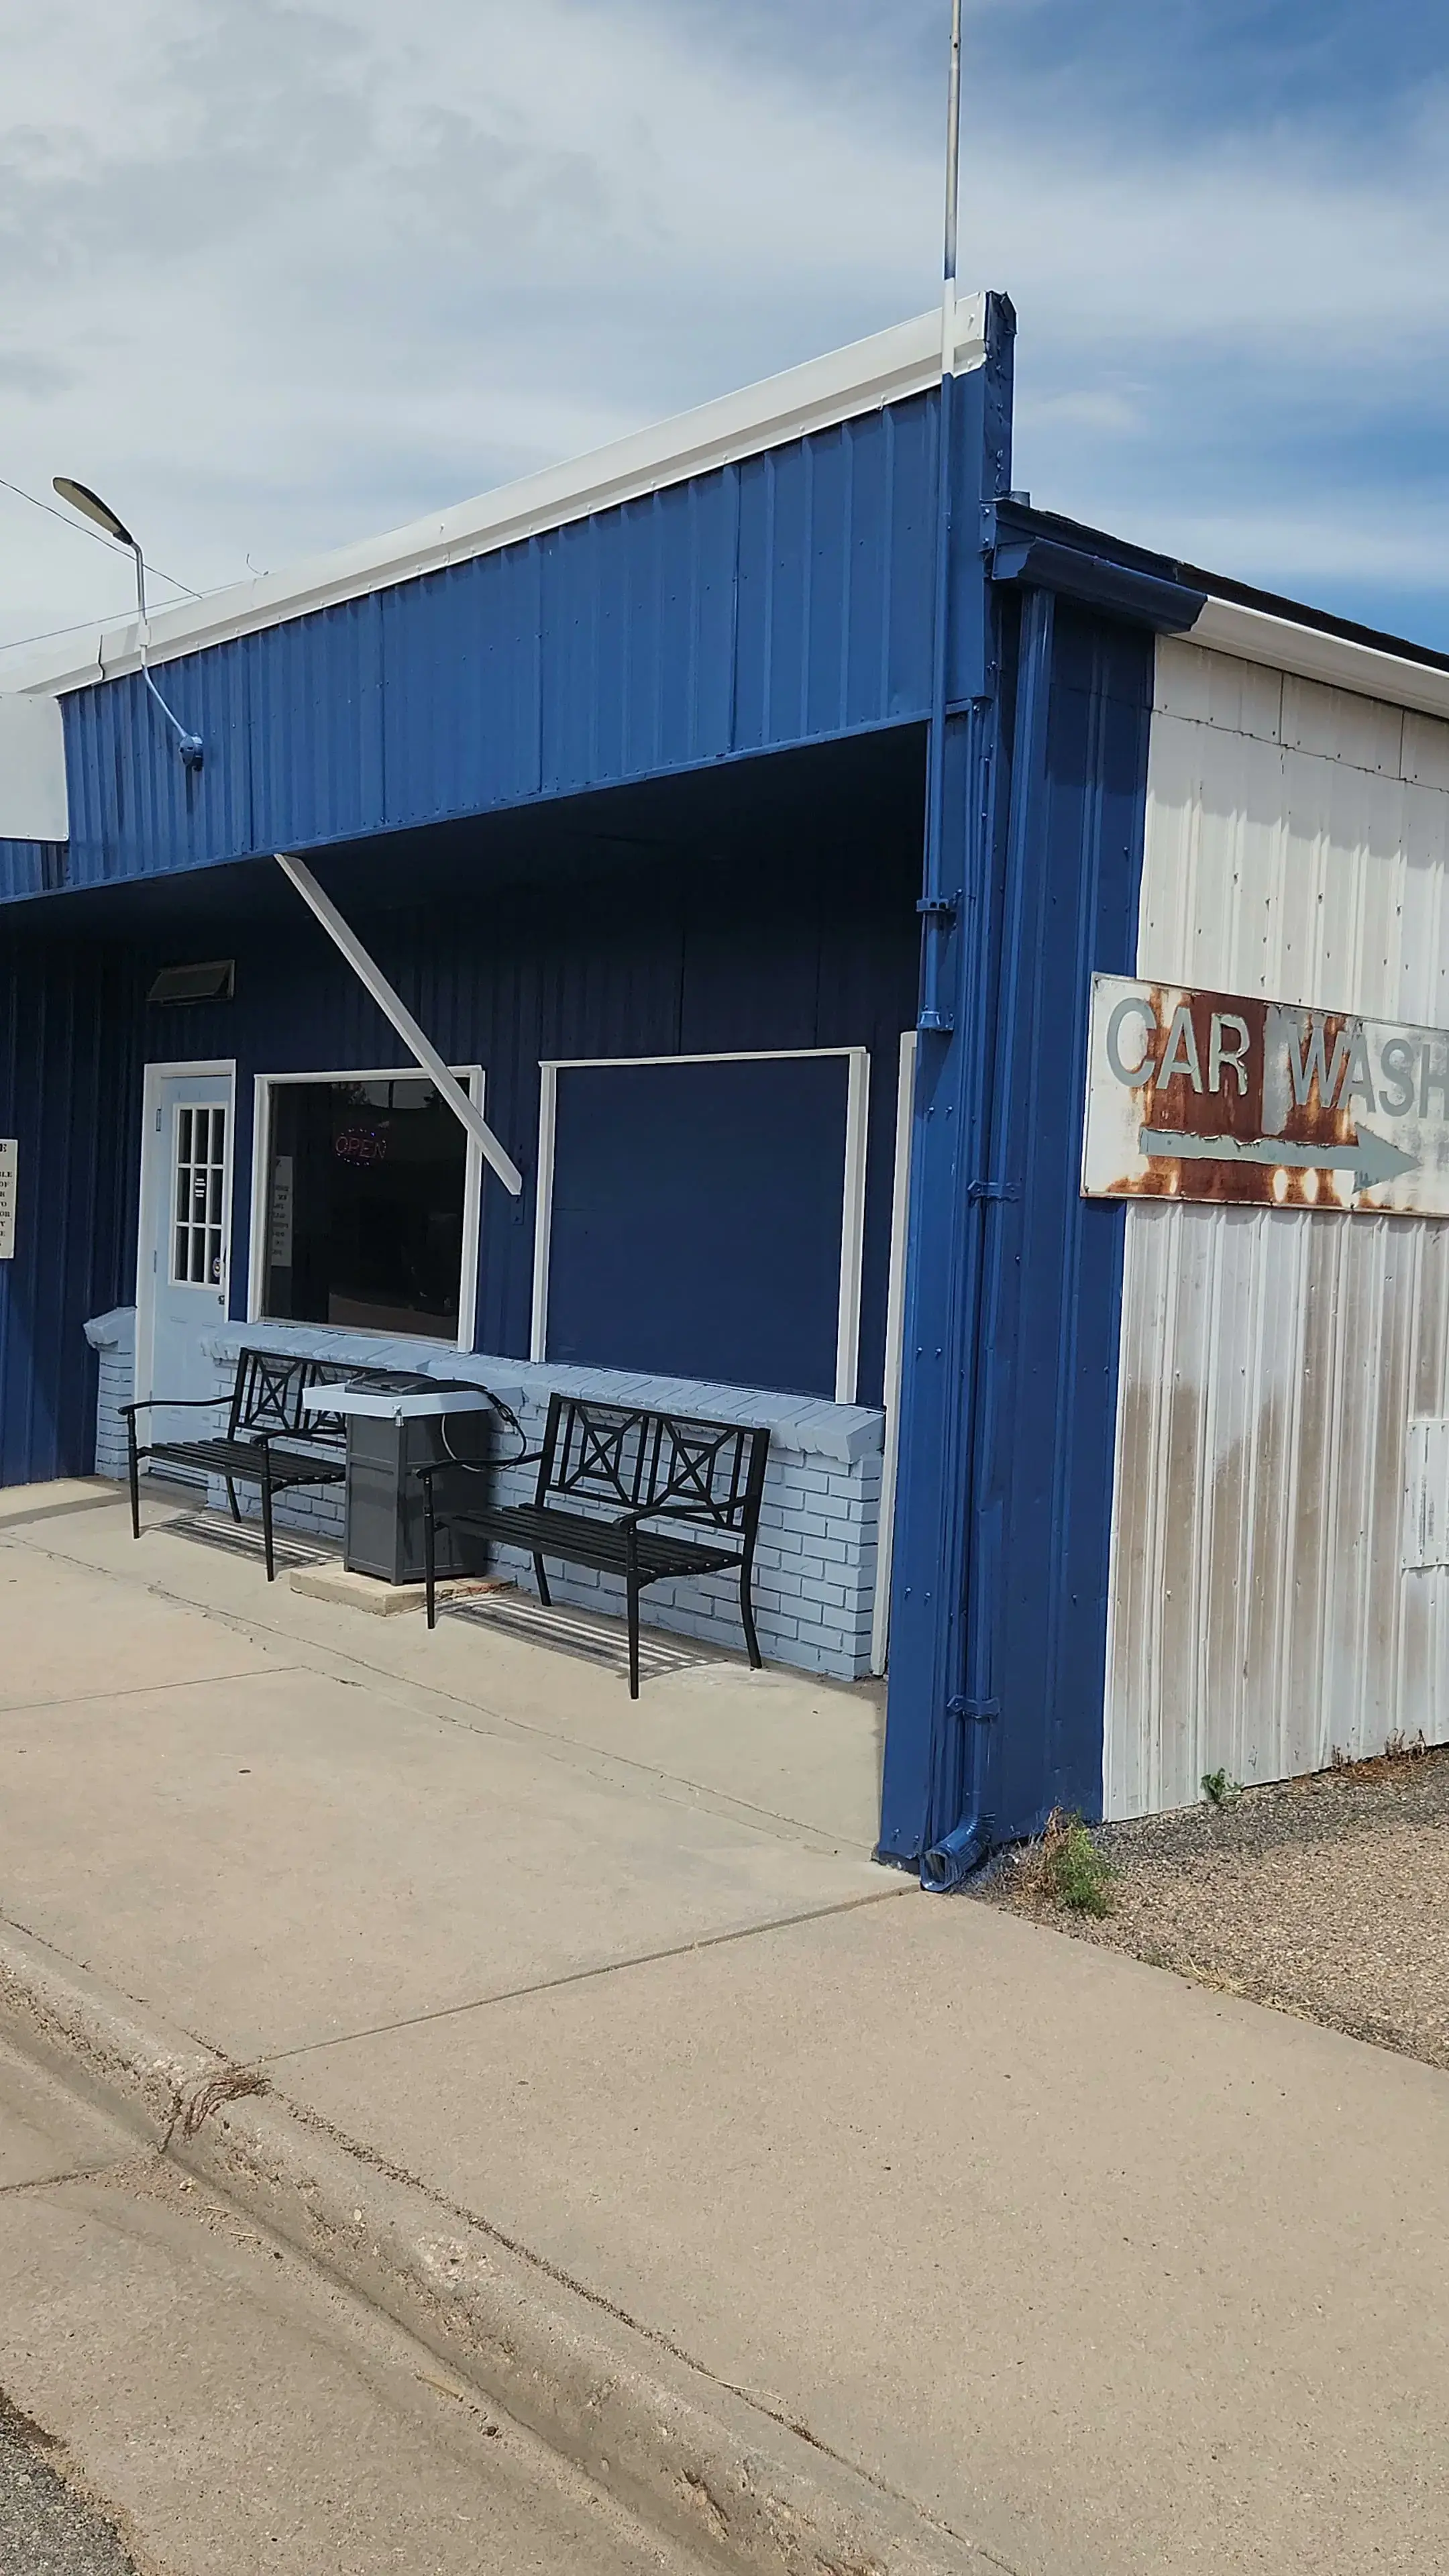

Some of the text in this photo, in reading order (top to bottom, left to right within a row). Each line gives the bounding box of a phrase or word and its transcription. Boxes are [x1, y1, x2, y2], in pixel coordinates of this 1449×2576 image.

[1106, 997, 1449, 1121] CAR WASH
[335, 1136, 384, 1159] OPEN
